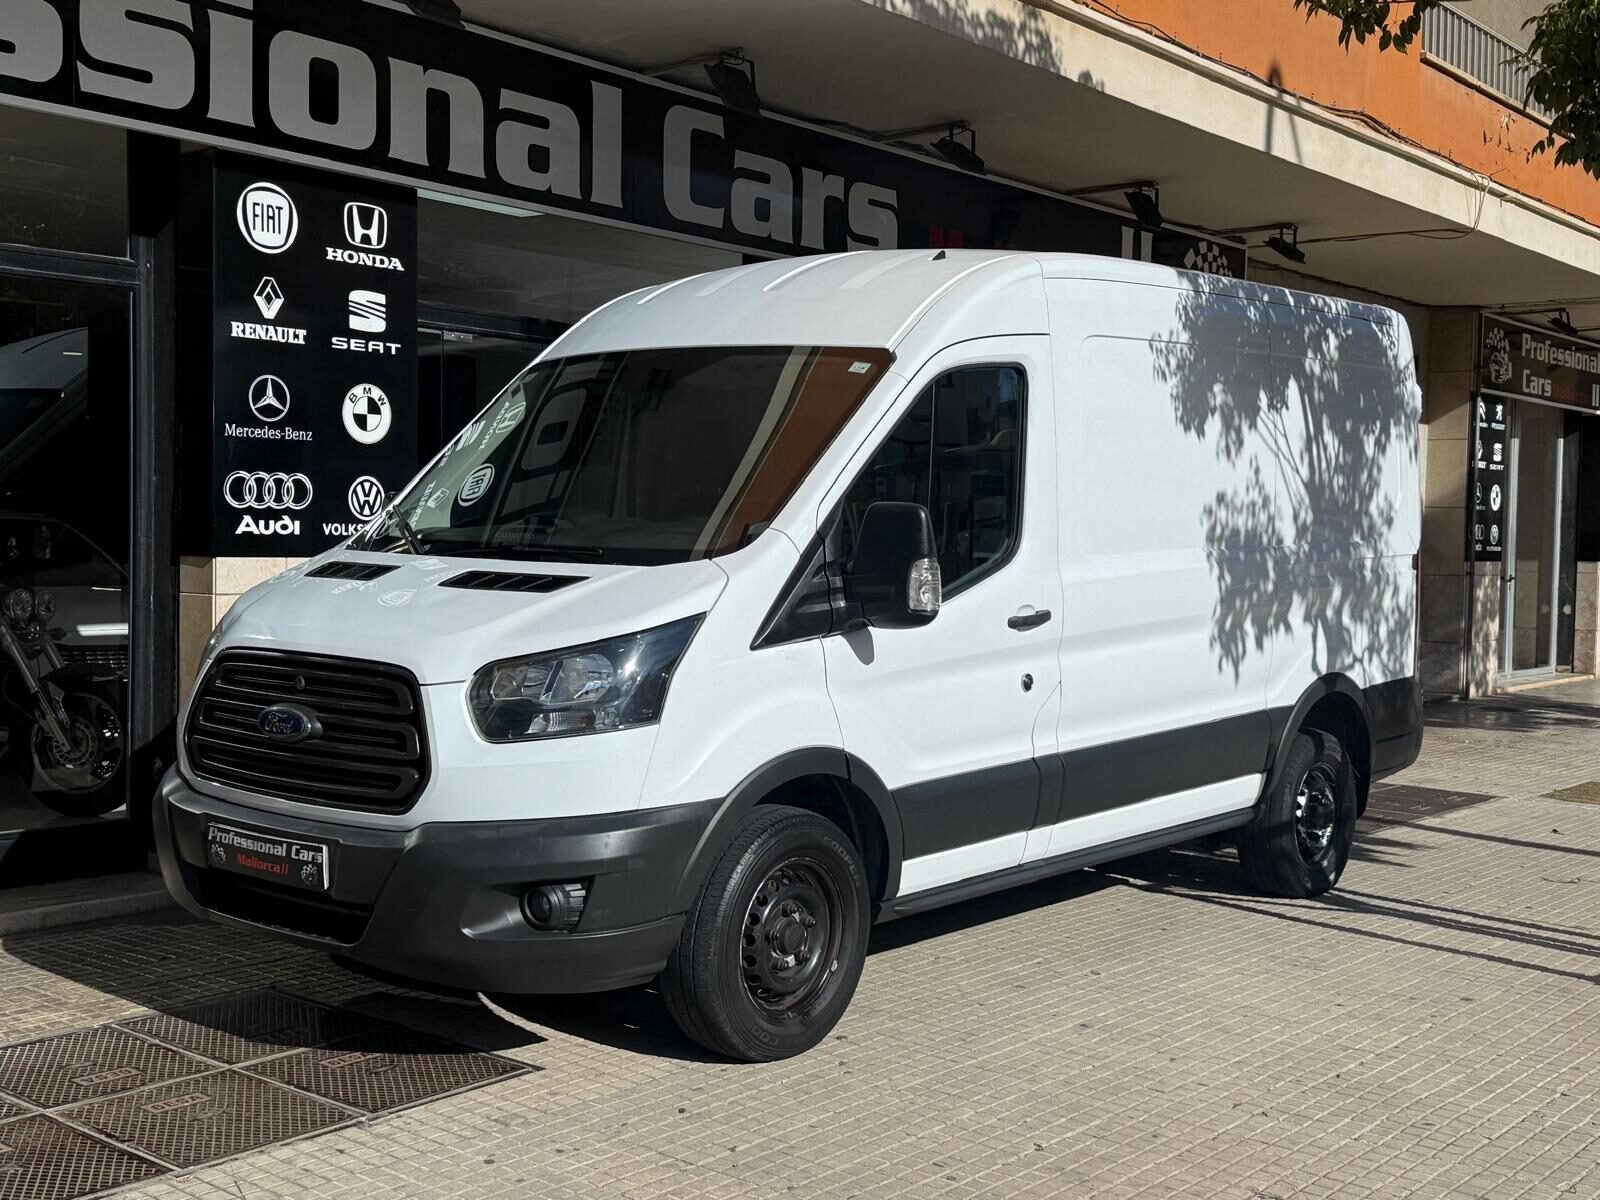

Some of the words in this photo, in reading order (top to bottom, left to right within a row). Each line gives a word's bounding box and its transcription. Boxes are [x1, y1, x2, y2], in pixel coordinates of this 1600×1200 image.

[663, 104, 899, 250] Cars
[252, 202, 283, 235] FIAT
[326, 247, 405, 271] HONDA
[230, 321, 307, 345] RENAULT
[331, 336, 401, 355] SEAT
[1521, 332, 1600, 375] Professional
[1522, 368, 1552, 397] Cars
[348, 386, 388, 407] BMW
[224, 422, 313, 441] Mercedes-Benz
[234, 515, 300, 535] Audi
[322, 523, 370, 536] VOLKS
[207, 826, 287, 857] Professional
[290, 844, 323, 864] Cars
